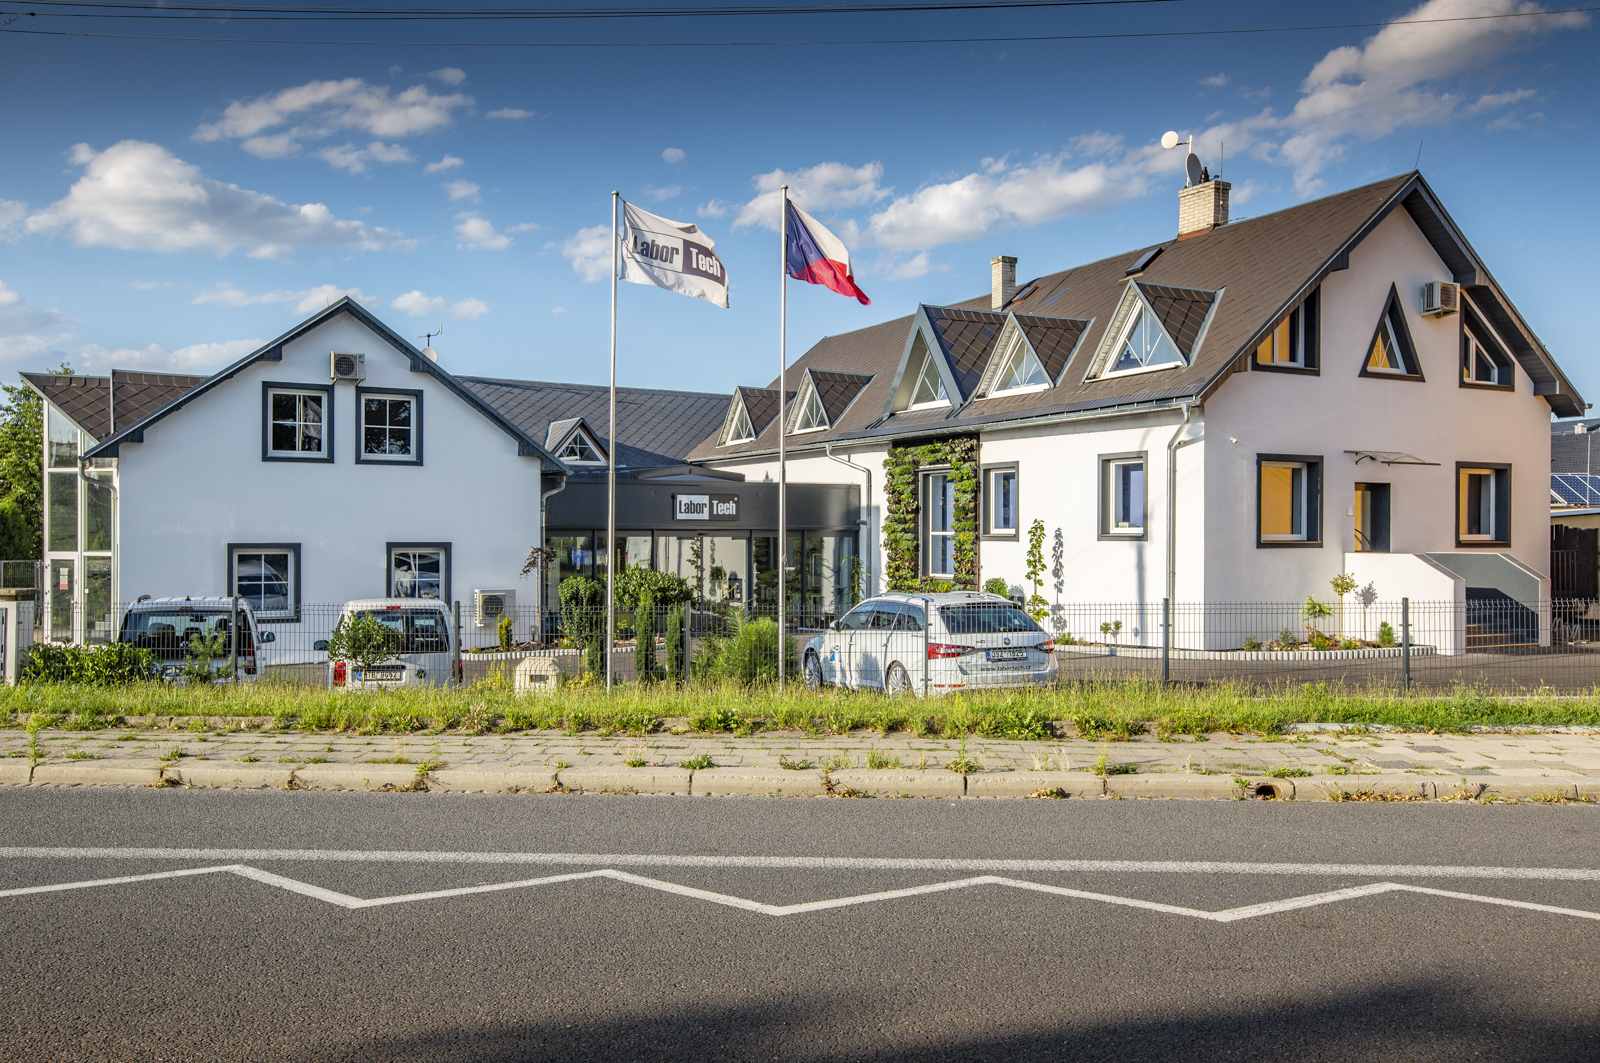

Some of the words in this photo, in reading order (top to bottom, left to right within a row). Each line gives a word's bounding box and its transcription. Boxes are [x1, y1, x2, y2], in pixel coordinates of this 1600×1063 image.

[632, 235, 680, 264] Labor
[690, 247, 721, 277] Tech
[678, 499, 707, 514] Labor
[712, 500, 736, 515] Tech
